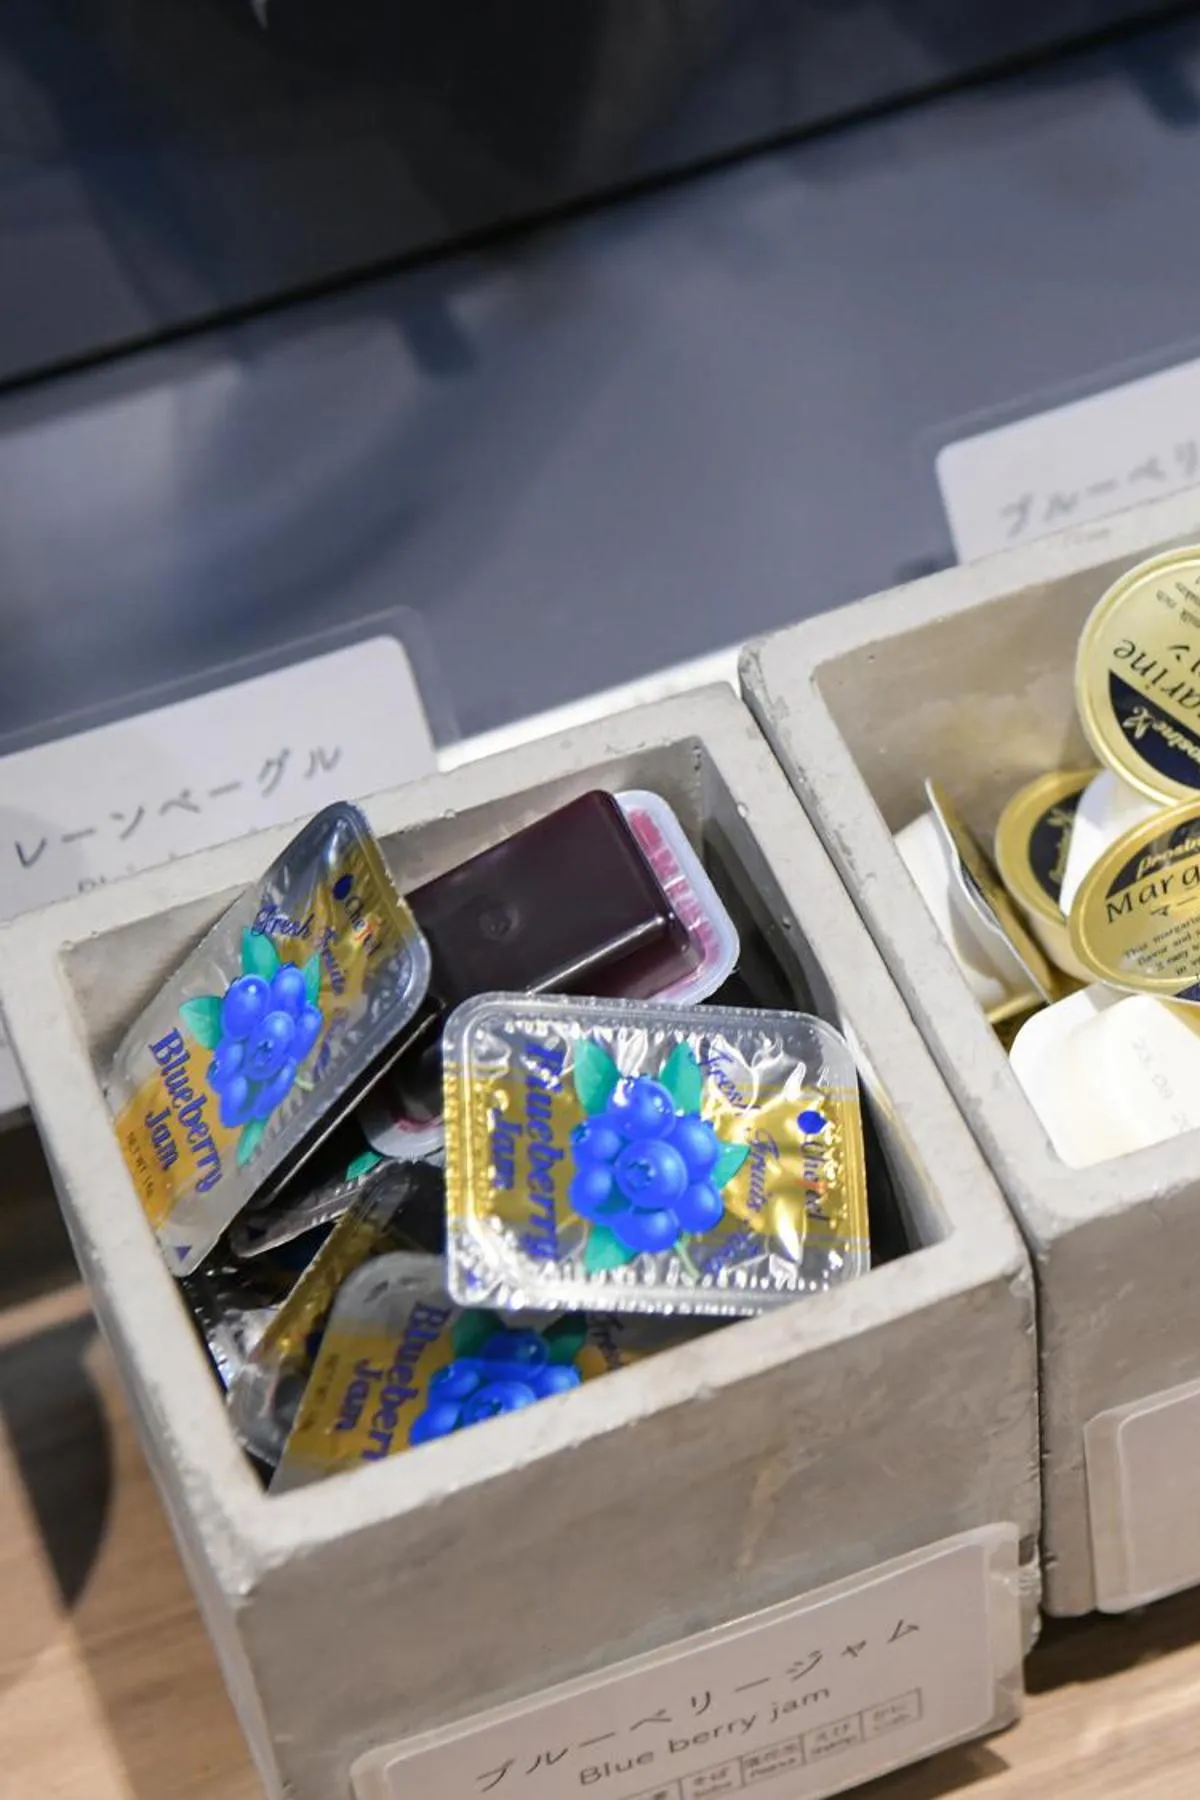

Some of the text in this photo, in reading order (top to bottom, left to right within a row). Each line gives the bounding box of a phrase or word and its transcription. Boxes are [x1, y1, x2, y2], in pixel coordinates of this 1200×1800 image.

[144, 1106, 179, 1172] Jam
[148, 1027, 223, 1193] Blueberry
[491, 1108, 523, 1189] Jam
[474, 1618, 921, 1794] ブルーベリージャム
[578, 1688, 832, 1787] Blue berry jam
